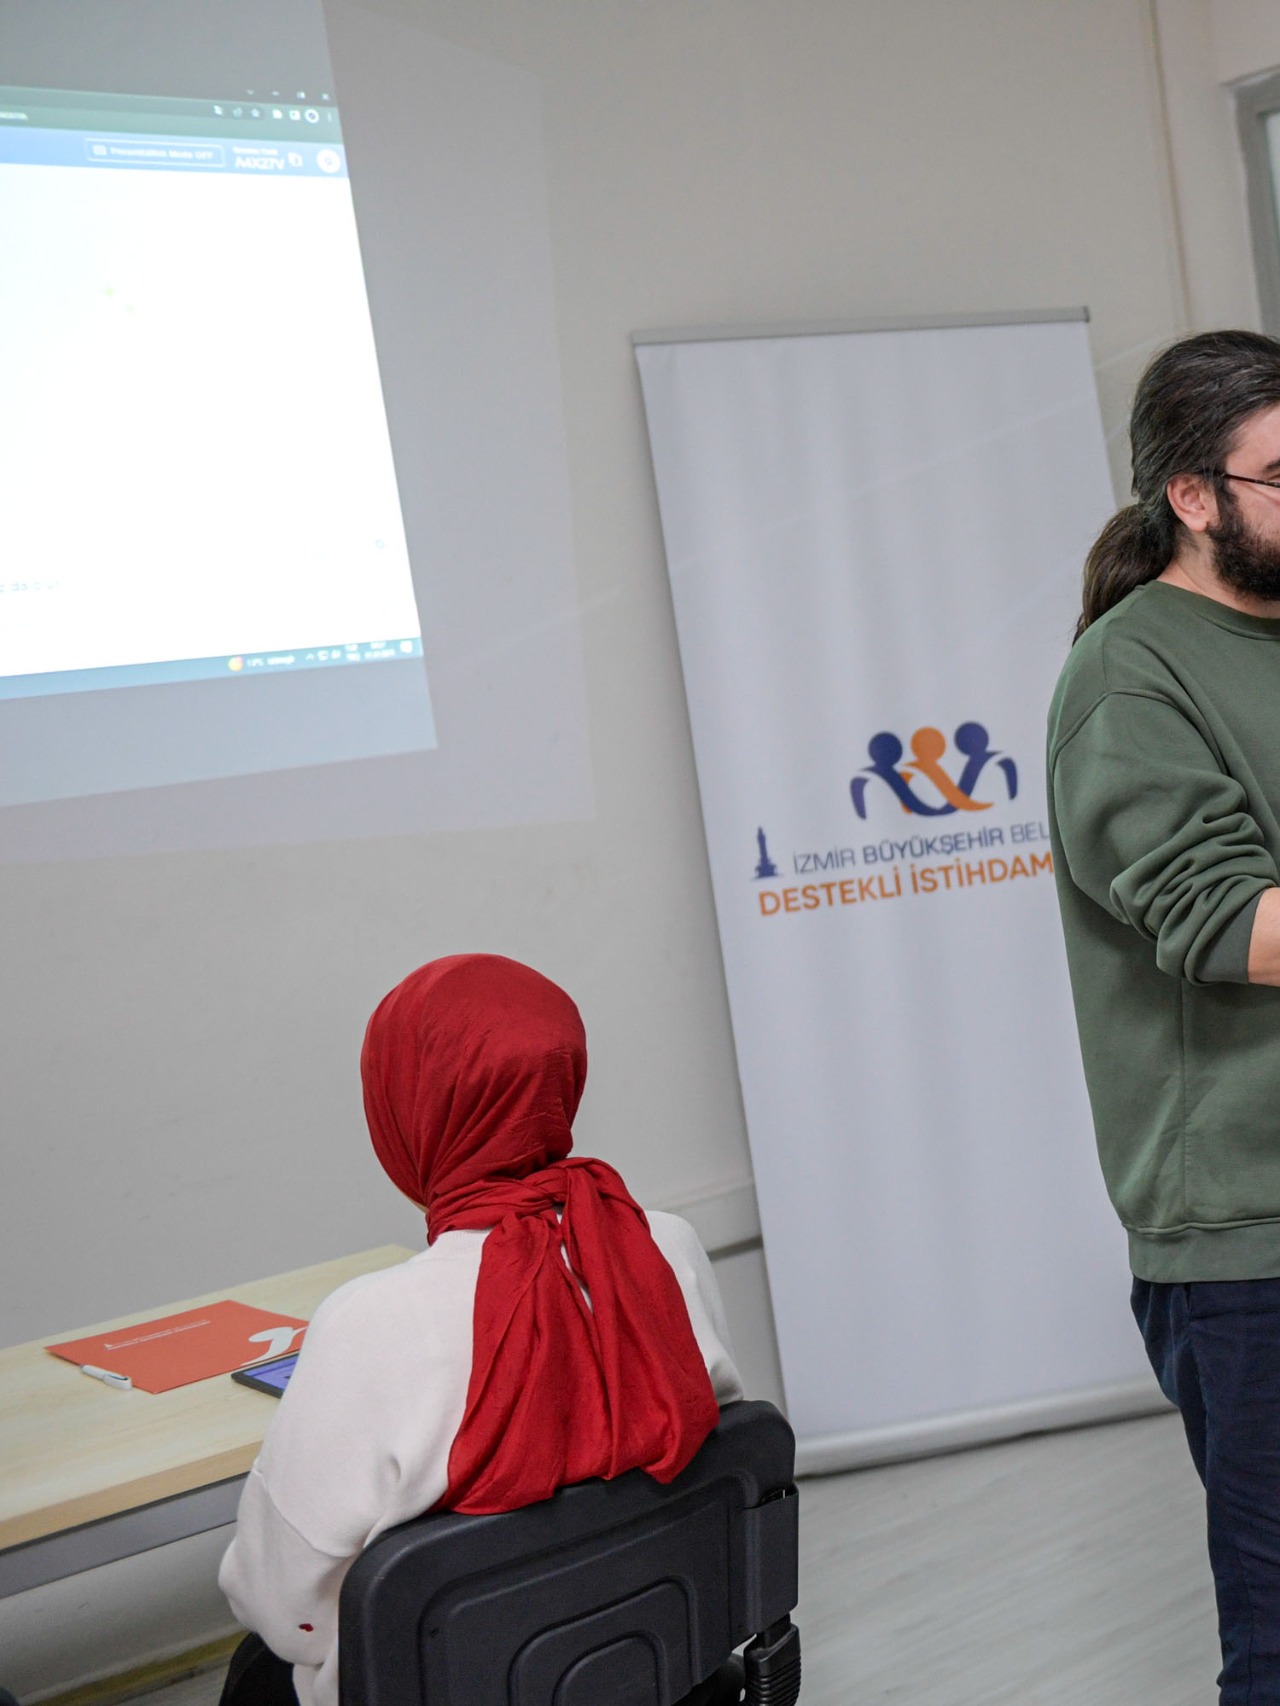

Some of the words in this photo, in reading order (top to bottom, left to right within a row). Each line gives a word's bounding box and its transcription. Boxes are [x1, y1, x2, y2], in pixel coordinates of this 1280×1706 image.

[793, 847, 857, 874] İZMİR
[863, 825, 1004, 864] BÜYÜKŞEHİR
[758, 864, 903, 917] DESTEKLİ
[910, 850, 1055, 895] İSTİHDAM
